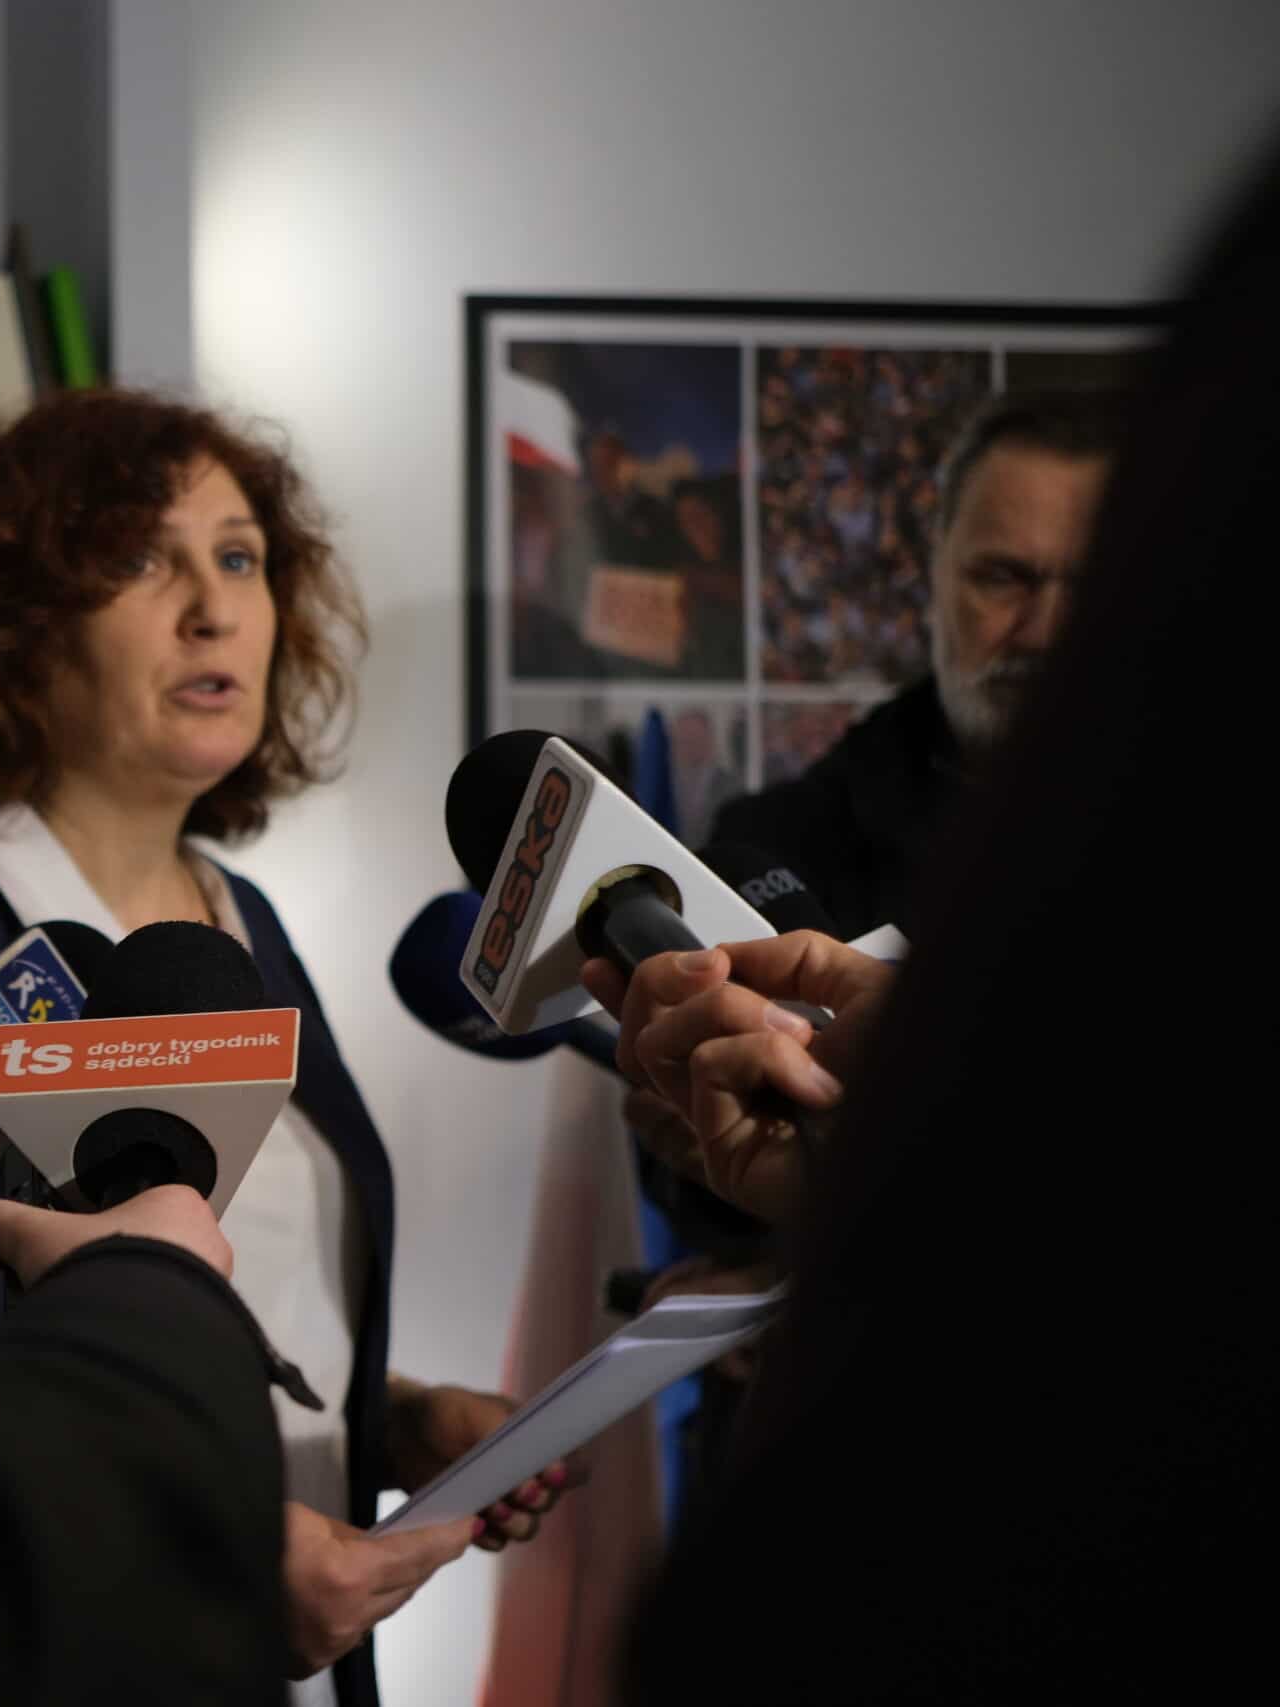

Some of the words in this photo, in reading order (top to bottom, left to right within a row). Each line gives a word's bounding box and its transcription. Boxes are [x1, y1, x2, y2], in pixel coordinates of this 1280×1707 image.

[480, 768, 571, 974] eska
[1, 1039, 73, 1076] ts
[88, 1040, 162, 1056] dobry
[170, 1033, 281, 1054] tygodnik
[84, 1051, 191, 1072] sądecki
